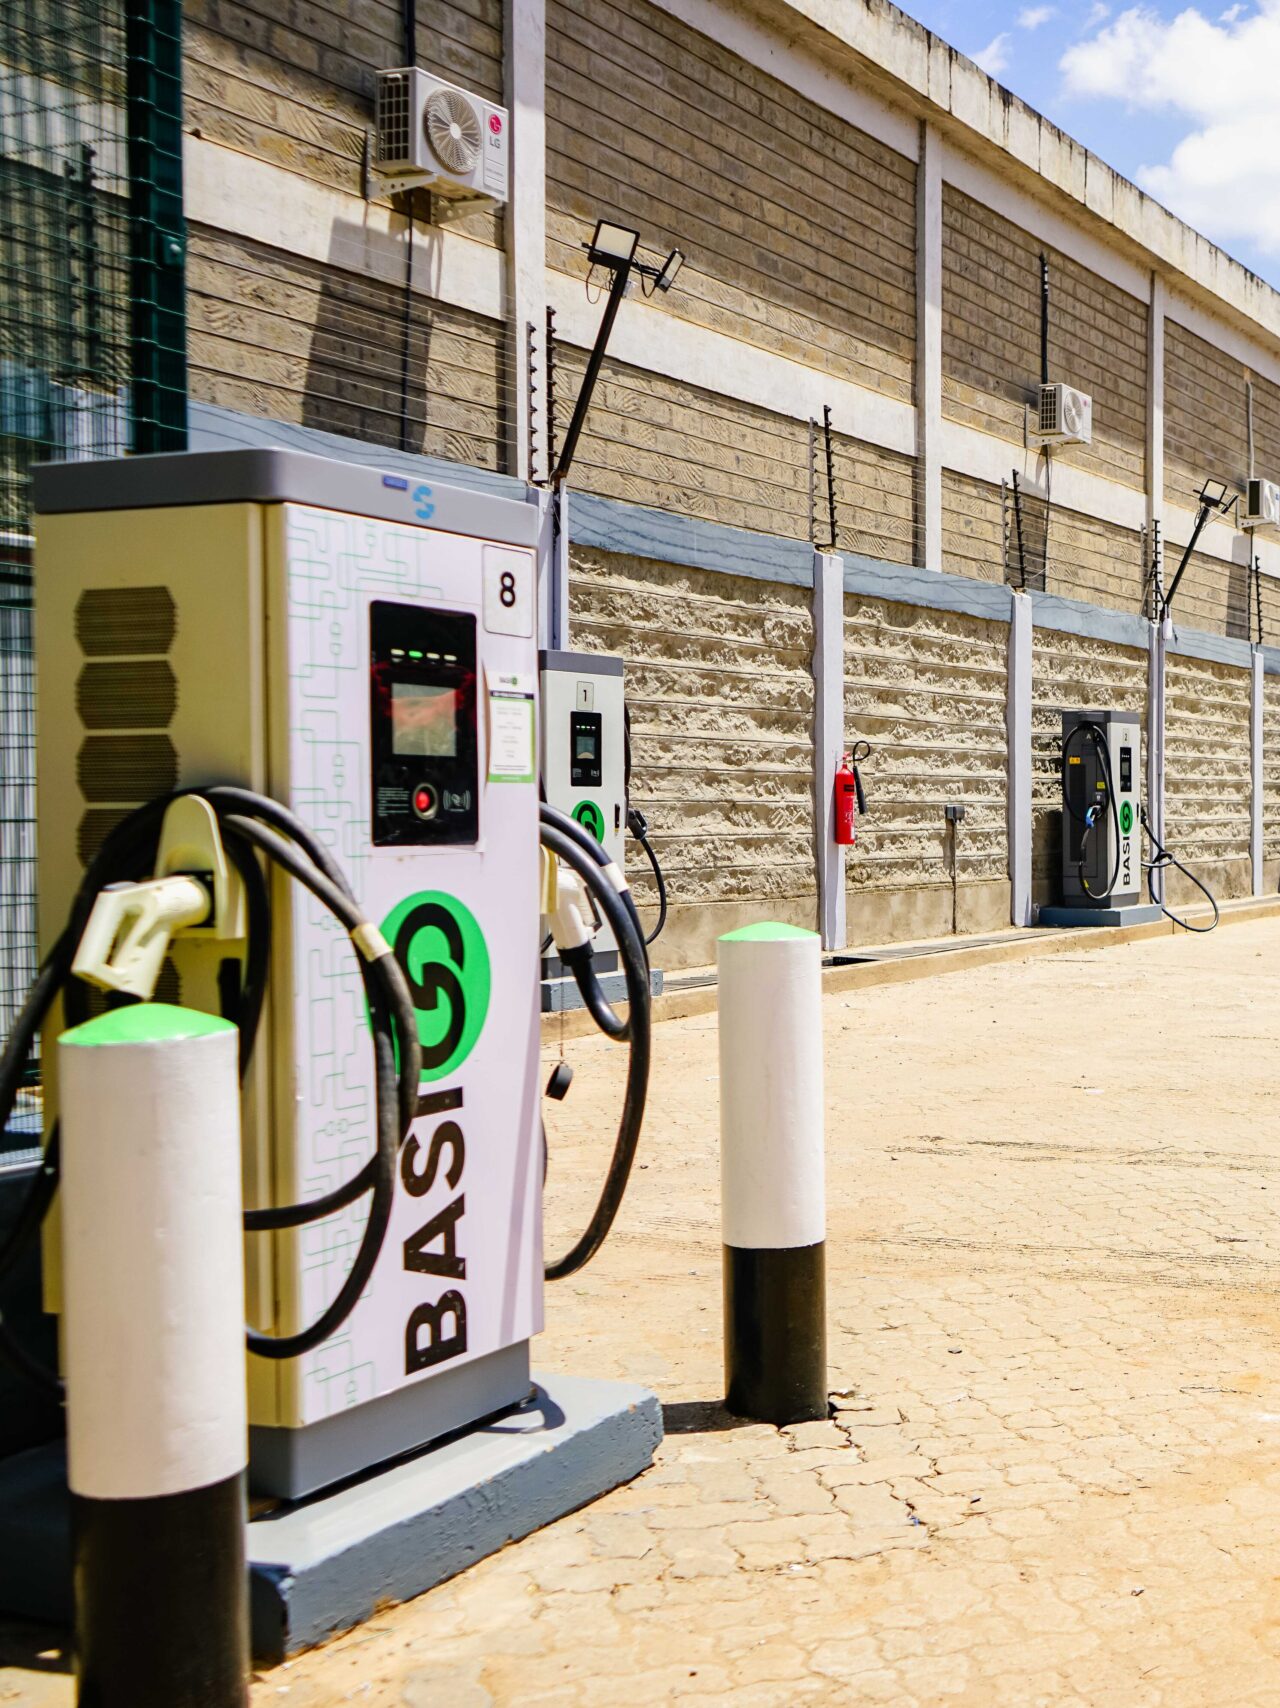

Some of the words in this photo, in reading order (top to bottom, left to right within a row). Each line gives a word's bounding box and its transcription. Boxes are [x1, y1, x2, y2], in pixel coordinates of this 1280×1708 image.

[489, 136, 501, 149] LG
[500, 571, 516, 608] 8
[582, 689, 587, 702] 1
